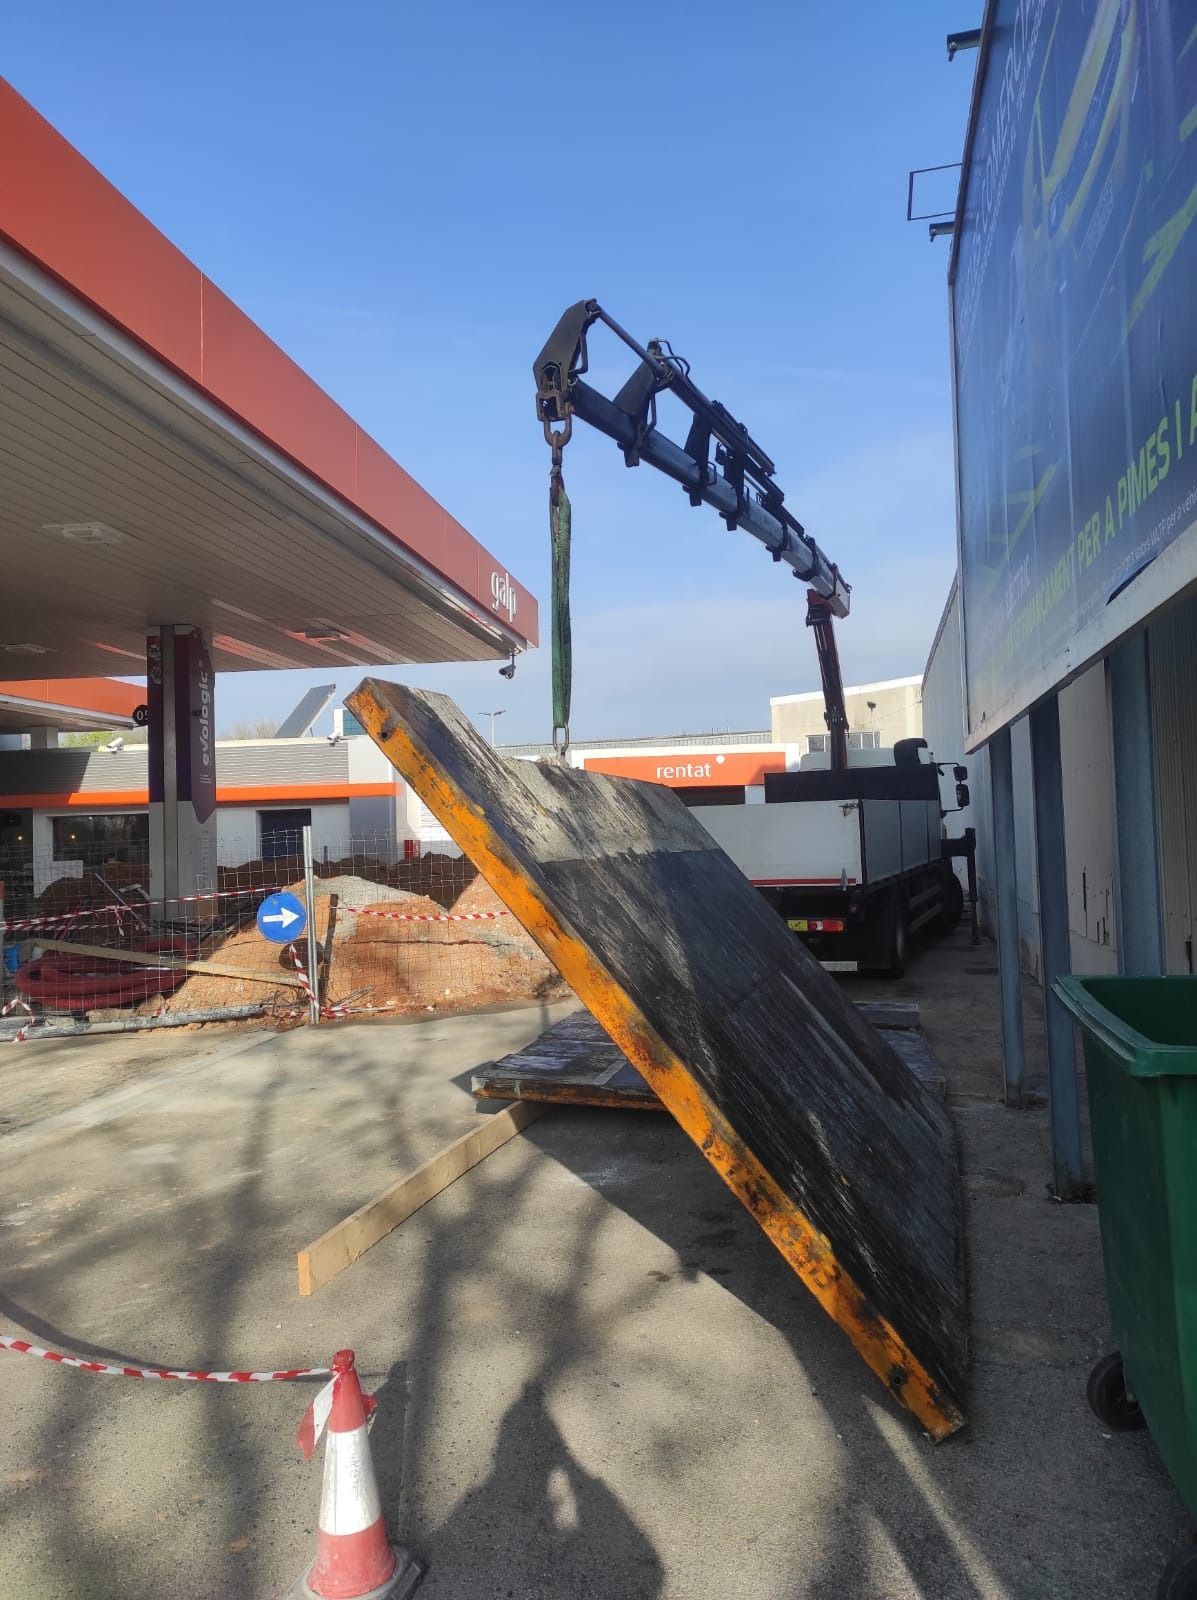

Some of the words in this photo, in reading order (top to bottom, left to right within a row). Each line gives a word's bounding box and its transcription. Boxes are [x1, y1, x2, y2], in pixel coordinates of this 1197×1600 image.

[1077, 511, 1102, 576] PER
[1105, 493, 1116, 547] A
[1117, 416, 1170, 530] PIMES
[1175, 398, 1183, 461] I
[491, 571, 517, 623] galp
[199, 672, 211, 767] evologic
[656, 762, 711, 779] rentat
